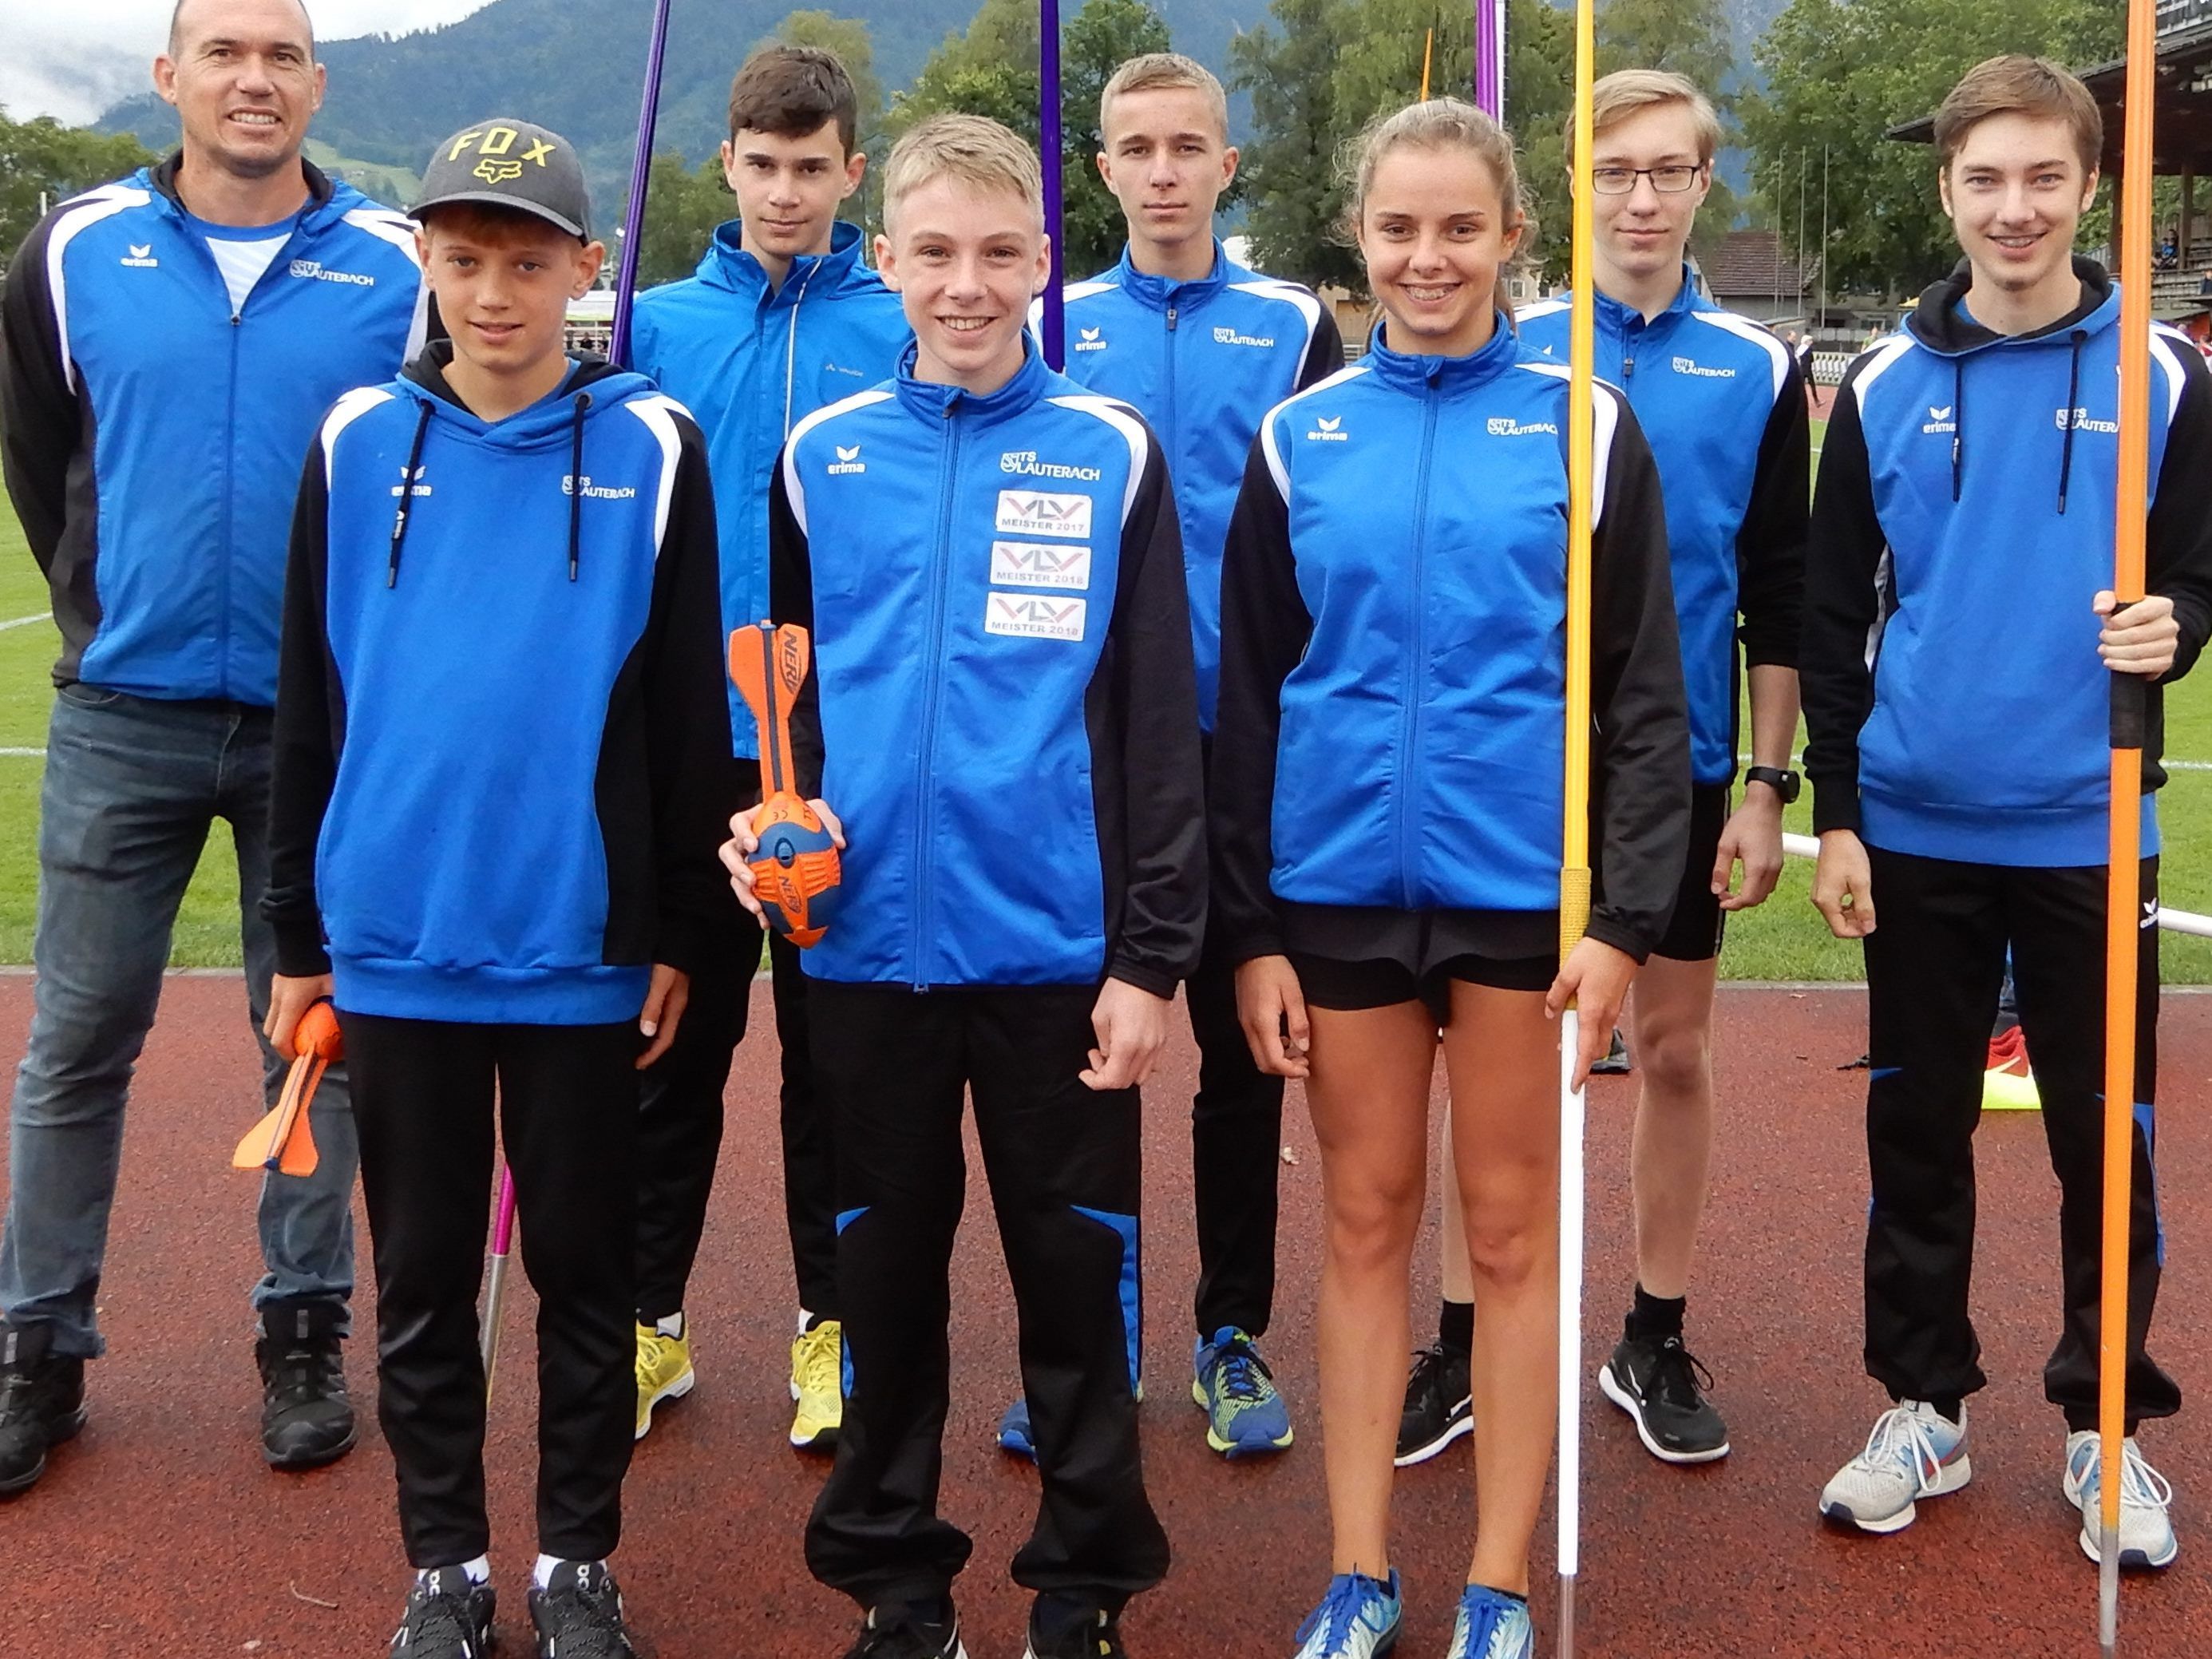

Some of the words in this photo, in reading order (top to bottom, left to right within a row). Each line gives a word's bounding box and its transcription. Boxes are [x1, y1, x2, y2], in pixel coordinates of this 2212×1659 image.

[449, 127, 556, 168] FOX
[303, 270, 375, 286] LAUTERACH
[1074, 341, 1107, 351] erima
[1225, 335, 1275, 347] LAUTERACH
[1682, 366, 1735, 378] LAUTERACH
[1308, 431, 1348, 441] erima
[1501, 423, 1558, 436] LAUTERAC
[828, 461, 866, 474] erima
[1016, 462, 1101, 481] LAUTERACH
[1001, 518, 1053, 530] MEISTER
[1056, 523, 1085, 532] 2017
[996, 571, 1051, 583] MEISTER
[1054, 575, 1084, 584] 2018
[991, 621, 1046, 633] MEISTER
[1049, 624, 1079, 636] 2018
